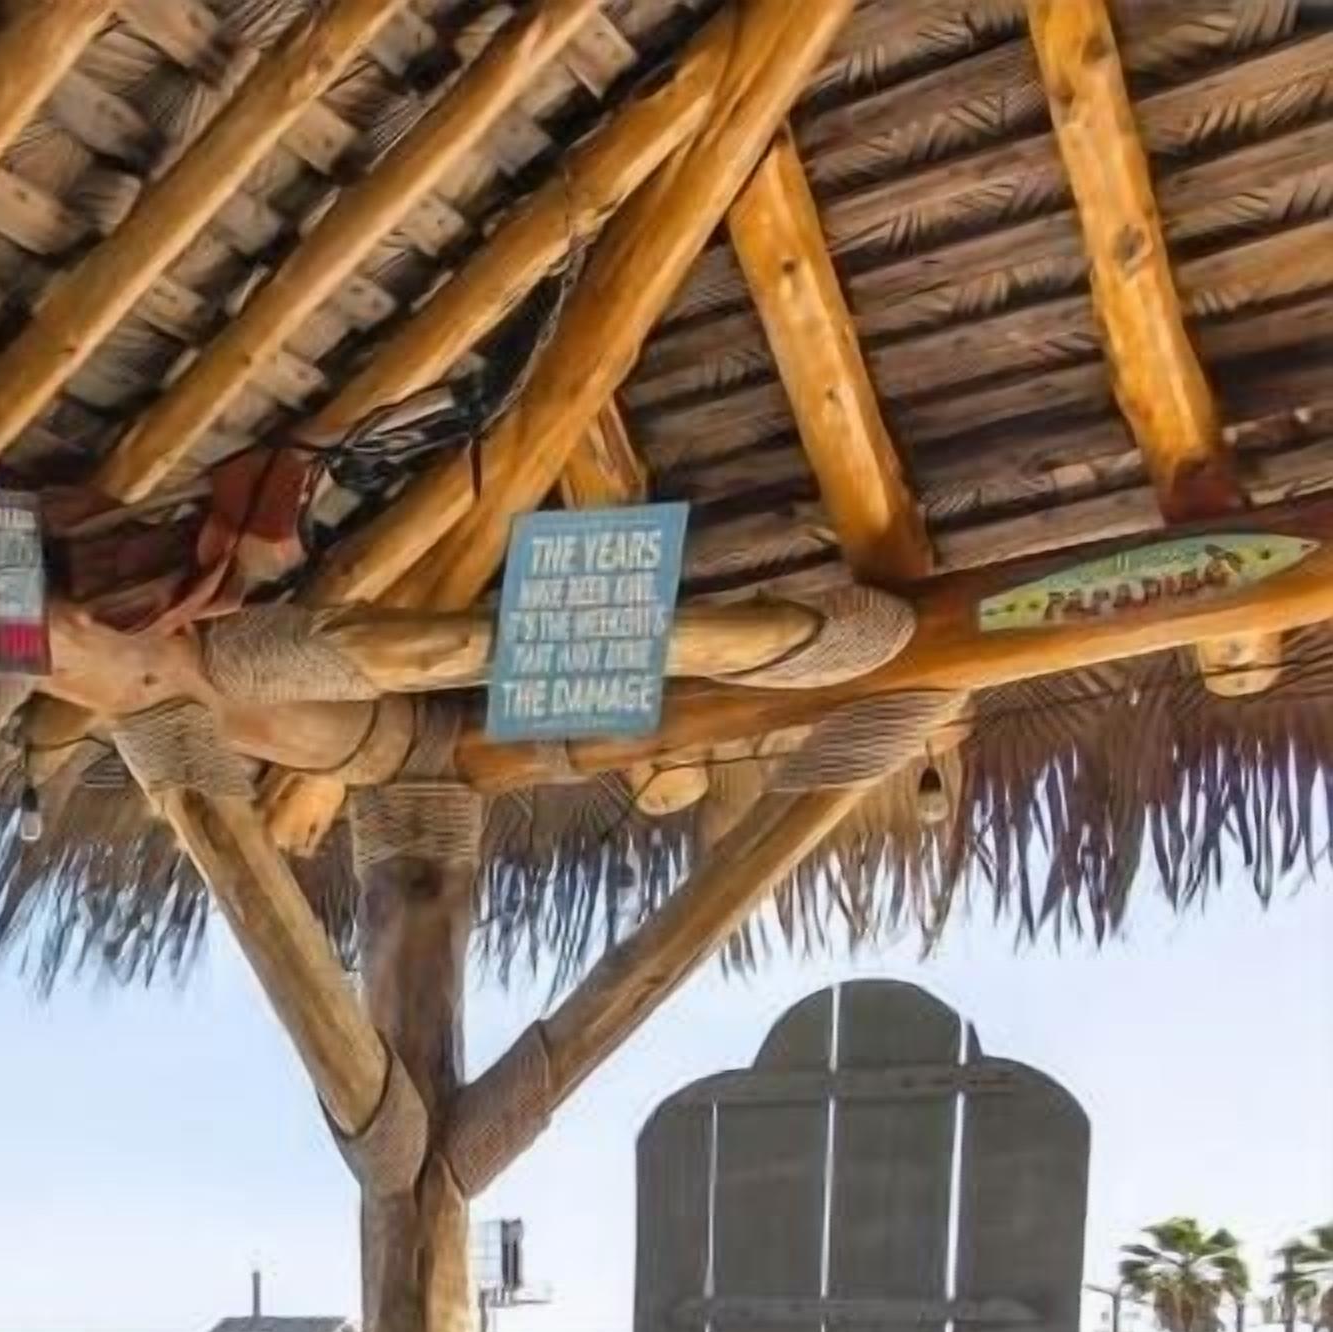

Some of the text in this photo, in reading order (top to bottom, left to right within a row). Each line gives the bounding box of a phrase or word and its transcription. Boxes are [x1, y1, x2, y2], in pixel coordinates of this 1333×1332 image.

[529, 529, 661, 577] THE YEARS
[501, 674, 655, 718] THE DAMAGE
